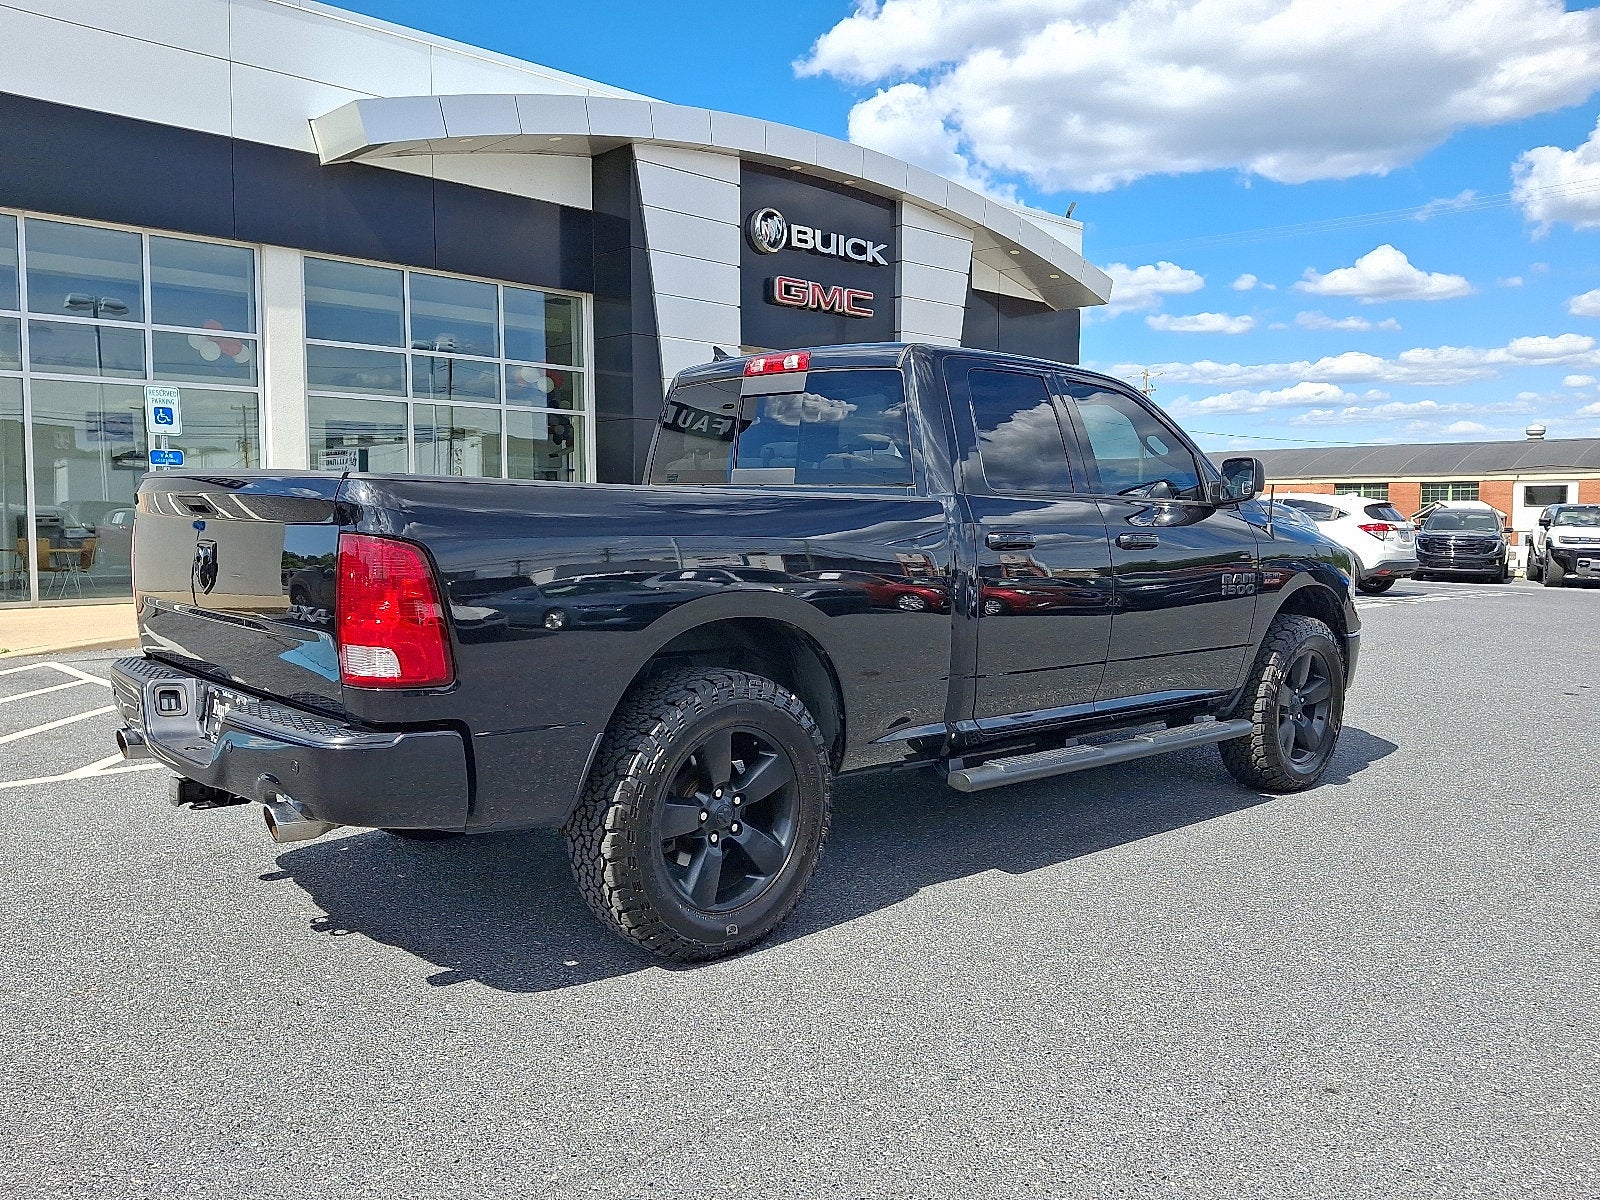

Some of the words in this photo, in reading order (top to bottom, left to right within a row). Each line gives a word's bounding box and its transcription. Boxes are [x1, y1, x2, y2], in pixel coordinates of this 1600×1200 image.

[791, 223, 889, 266] BUICK
[774, 275, 874, 317] GMC
[148, 389, 177, 398] RESERVED
[151, 397, 175, 405] PARKING
[1221, 572, 1256, 584] RAM
[1221, 583, 1256, 595] 1500
